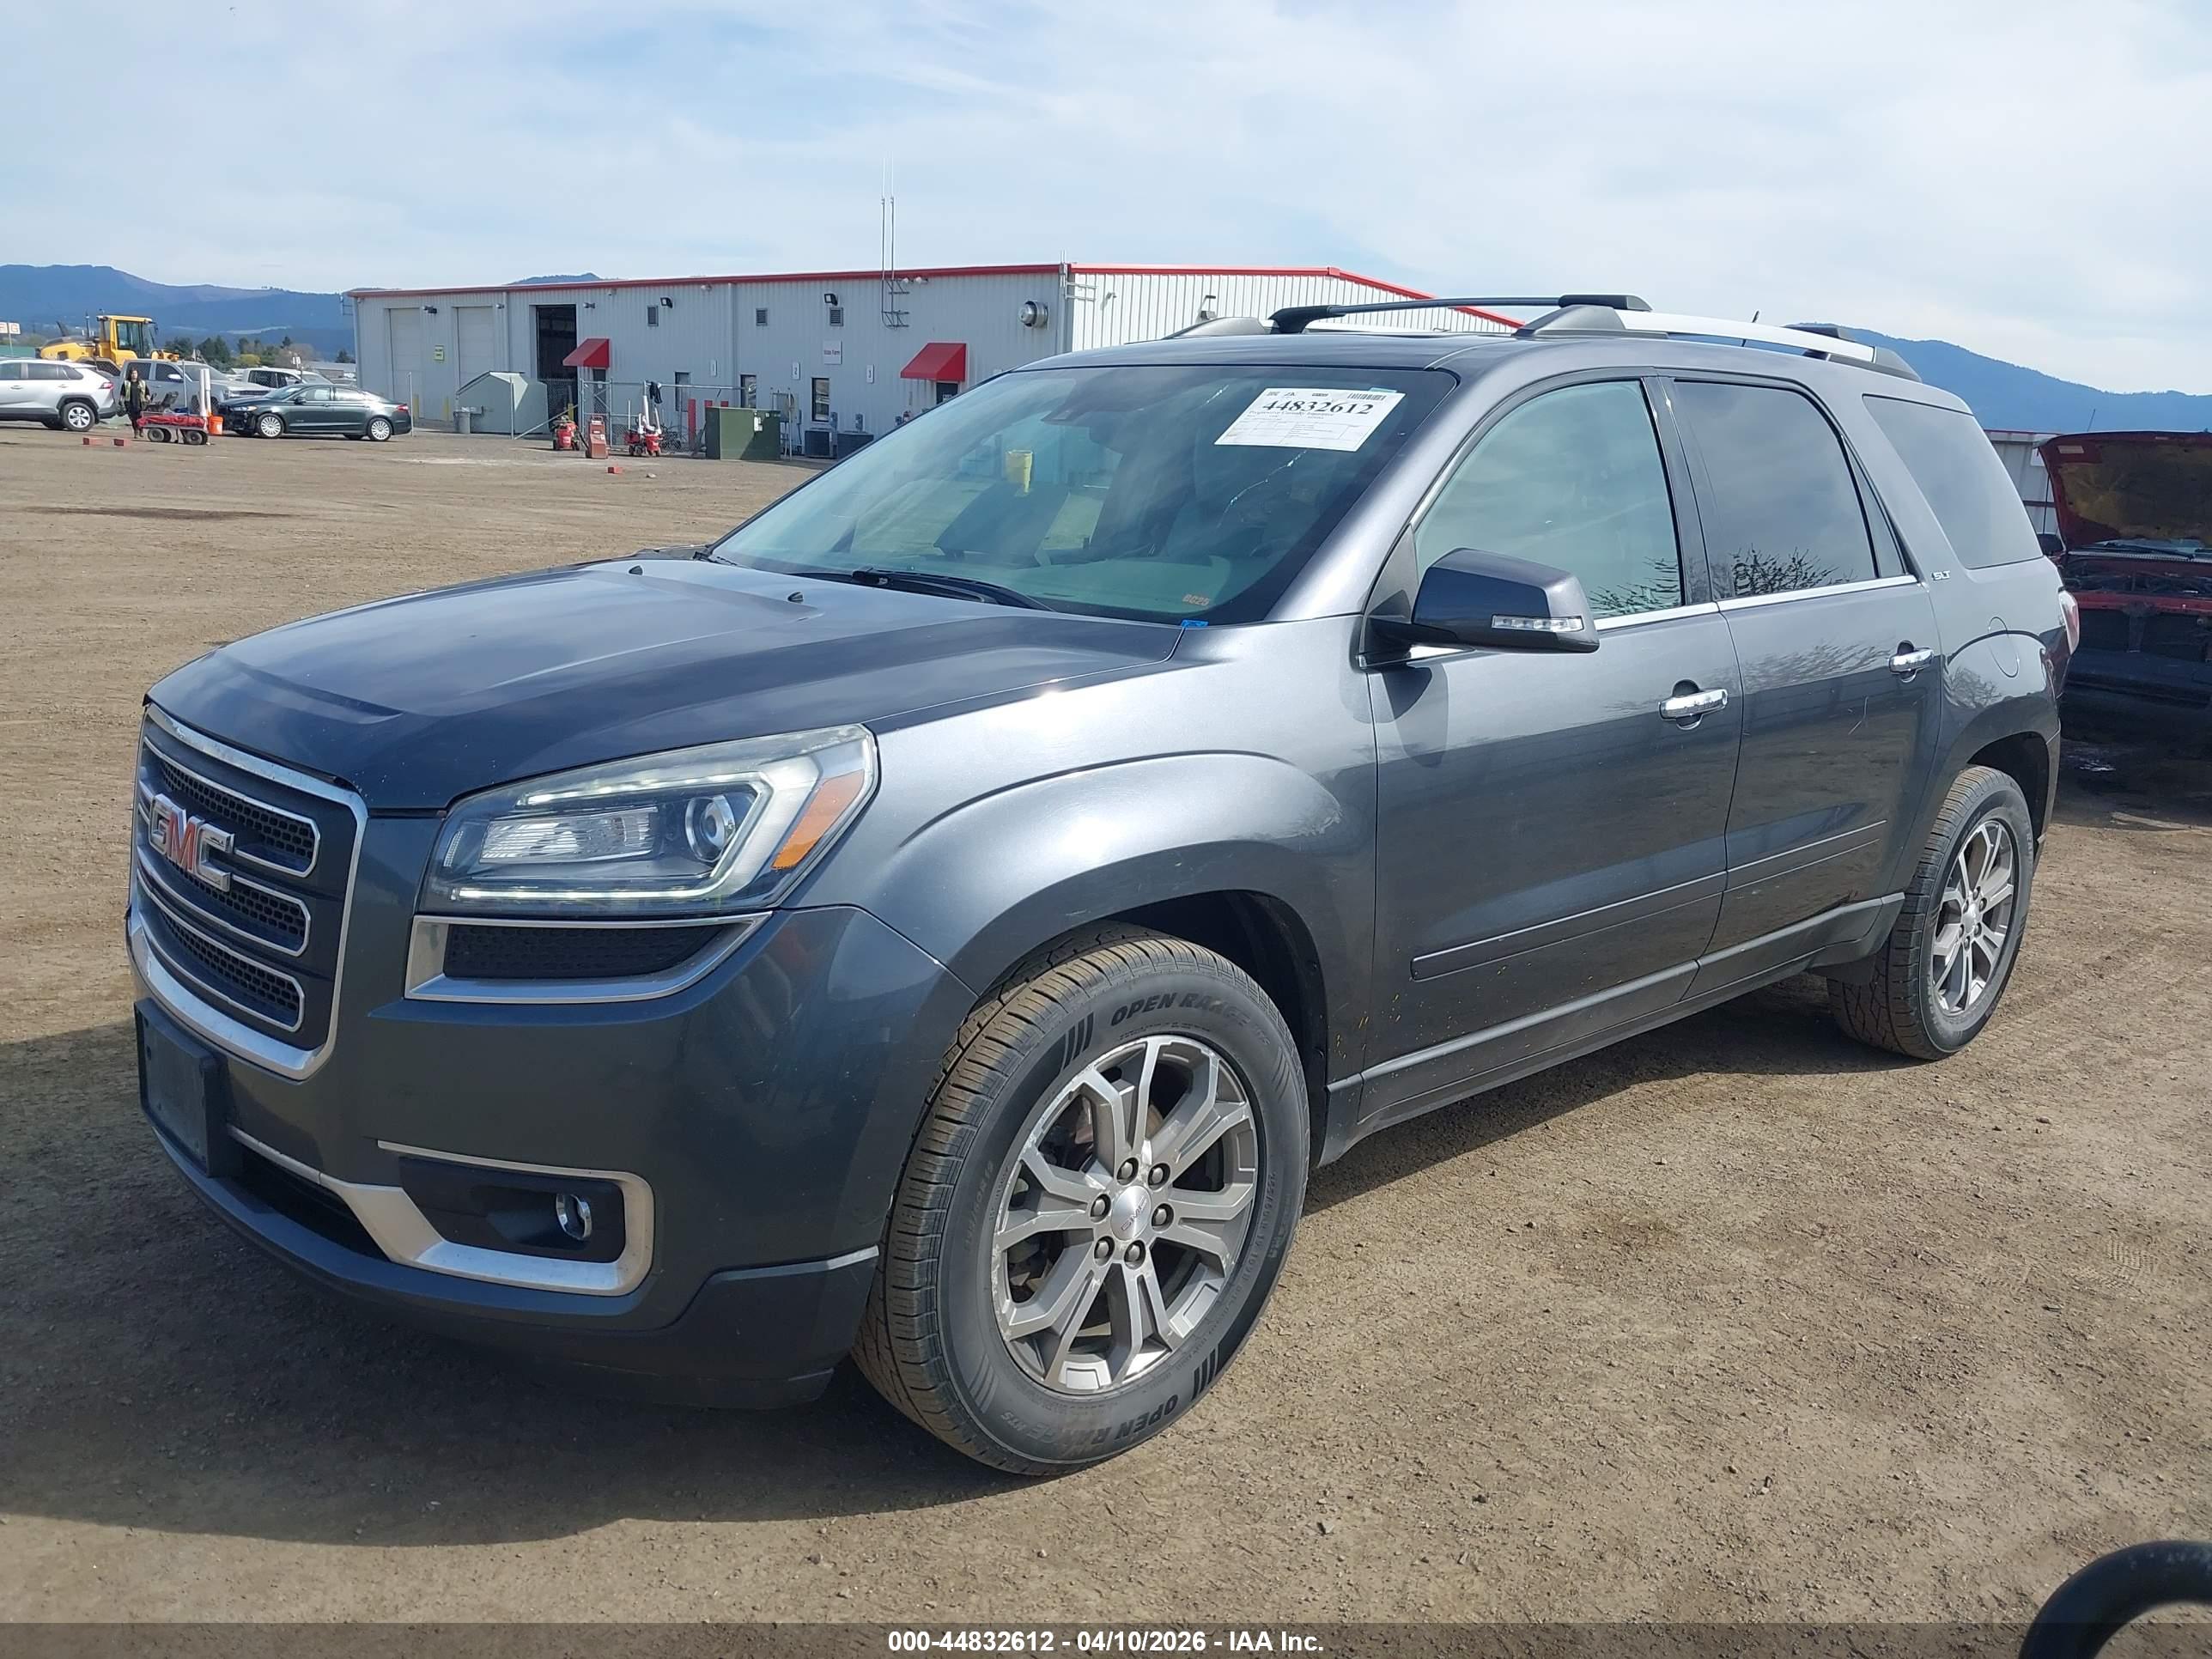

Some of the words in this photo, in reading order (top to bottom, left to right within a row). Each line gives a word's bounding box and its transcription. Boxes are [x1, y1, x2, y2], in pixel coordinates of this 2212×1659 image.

[1263, 400, 1374, 415] 44832612
[1932, 570, 1951, 580] SLT
[149, 793, 234, 892] GMC
[1110, 992, 1177, 1027] OPEN
[1121, 1194, 1147, 1231] GMC
[1114, 1394, 1179, 1441] OPEN
